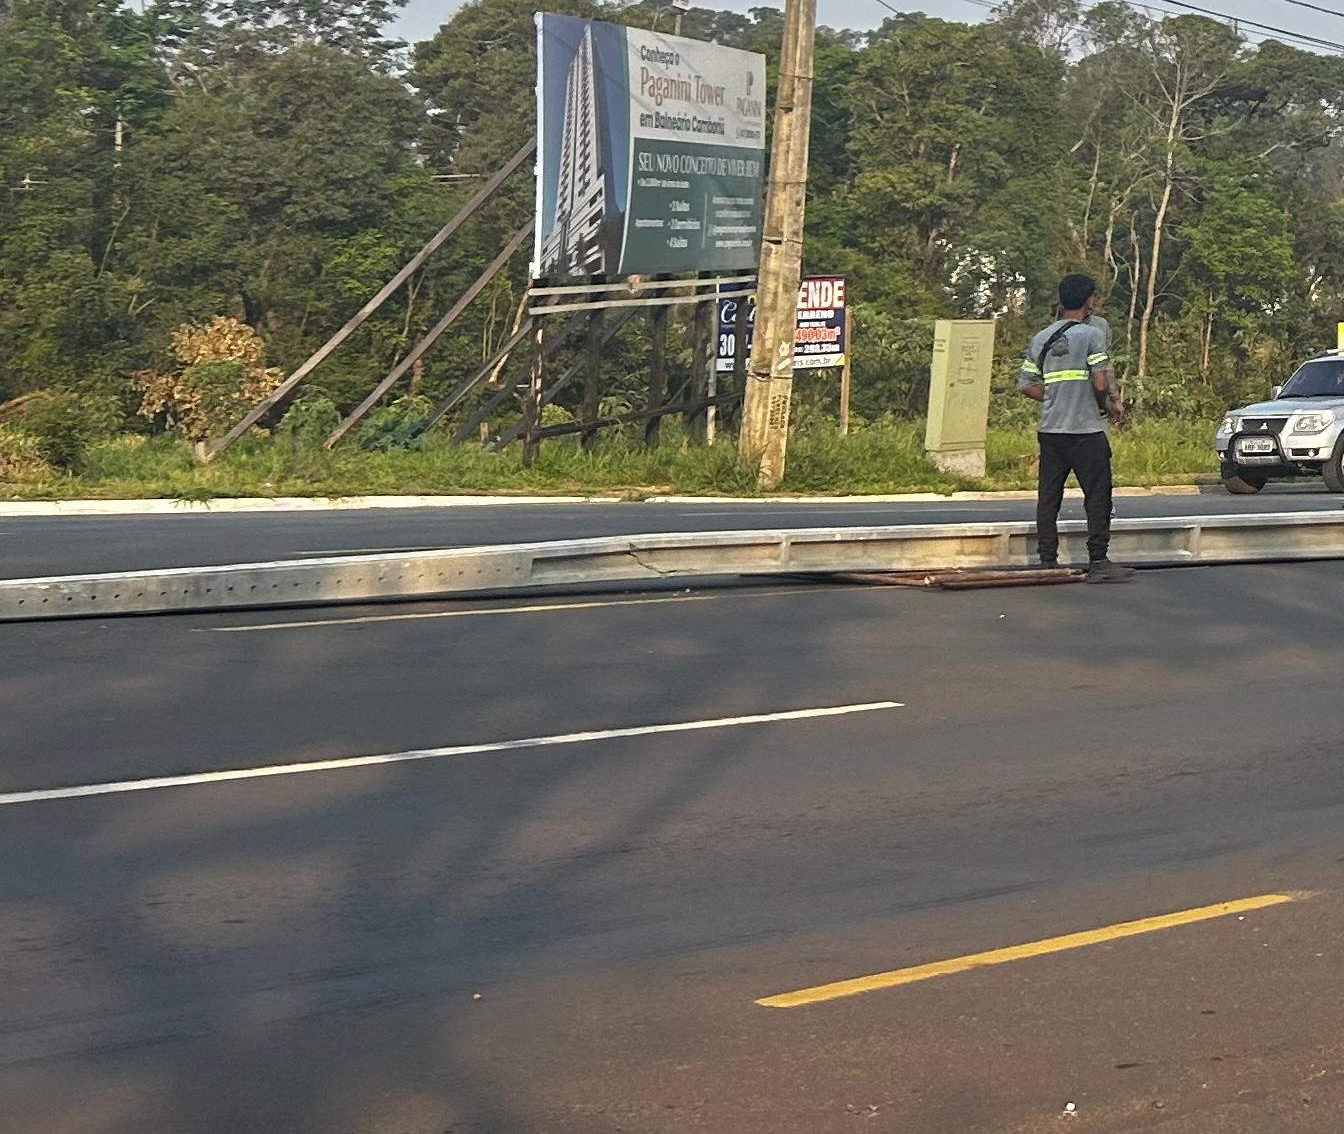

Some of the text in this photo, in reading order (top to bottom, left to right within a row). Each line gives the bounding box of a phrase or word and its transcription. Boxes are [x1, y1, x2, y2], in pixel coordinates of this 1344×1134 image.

[641, 45, 680, 69] Conheça o
[641, 66, 725, 106] Paganini Tower
[640, 112, 654, 127] em
[639, 152, 654, 172] SEU
[656, 154, 679, 174] NOVO
[797, 280, 845, 308] ENDE
